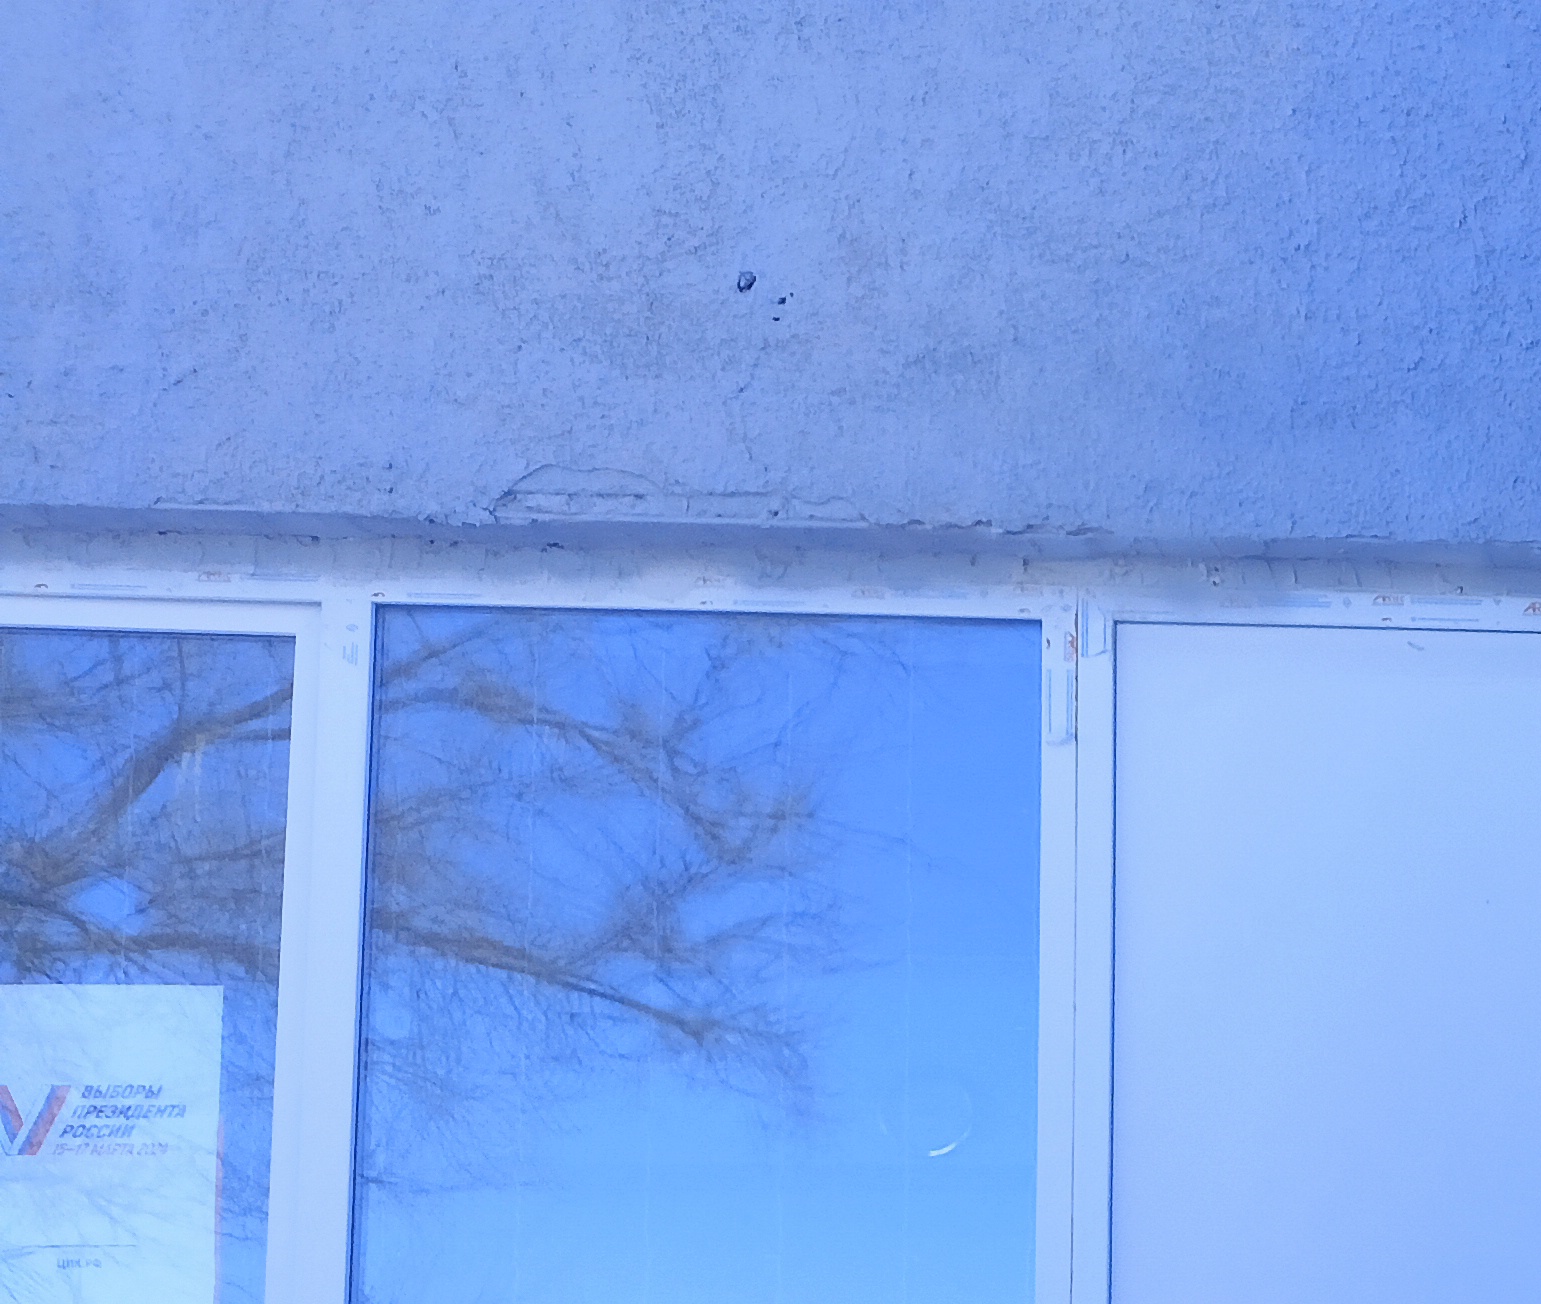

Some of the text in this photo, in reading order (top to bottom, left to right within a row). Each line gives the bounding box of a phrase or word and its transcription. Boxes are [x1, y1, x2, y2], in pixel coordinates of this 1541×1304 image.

[81, 1084, 163, 1099] ВЫБОРЫ
[71, 1104, 187, 1121] ПРЕЗИДЕНТА
[59, 1123, 137, 1139] РОССИИ
